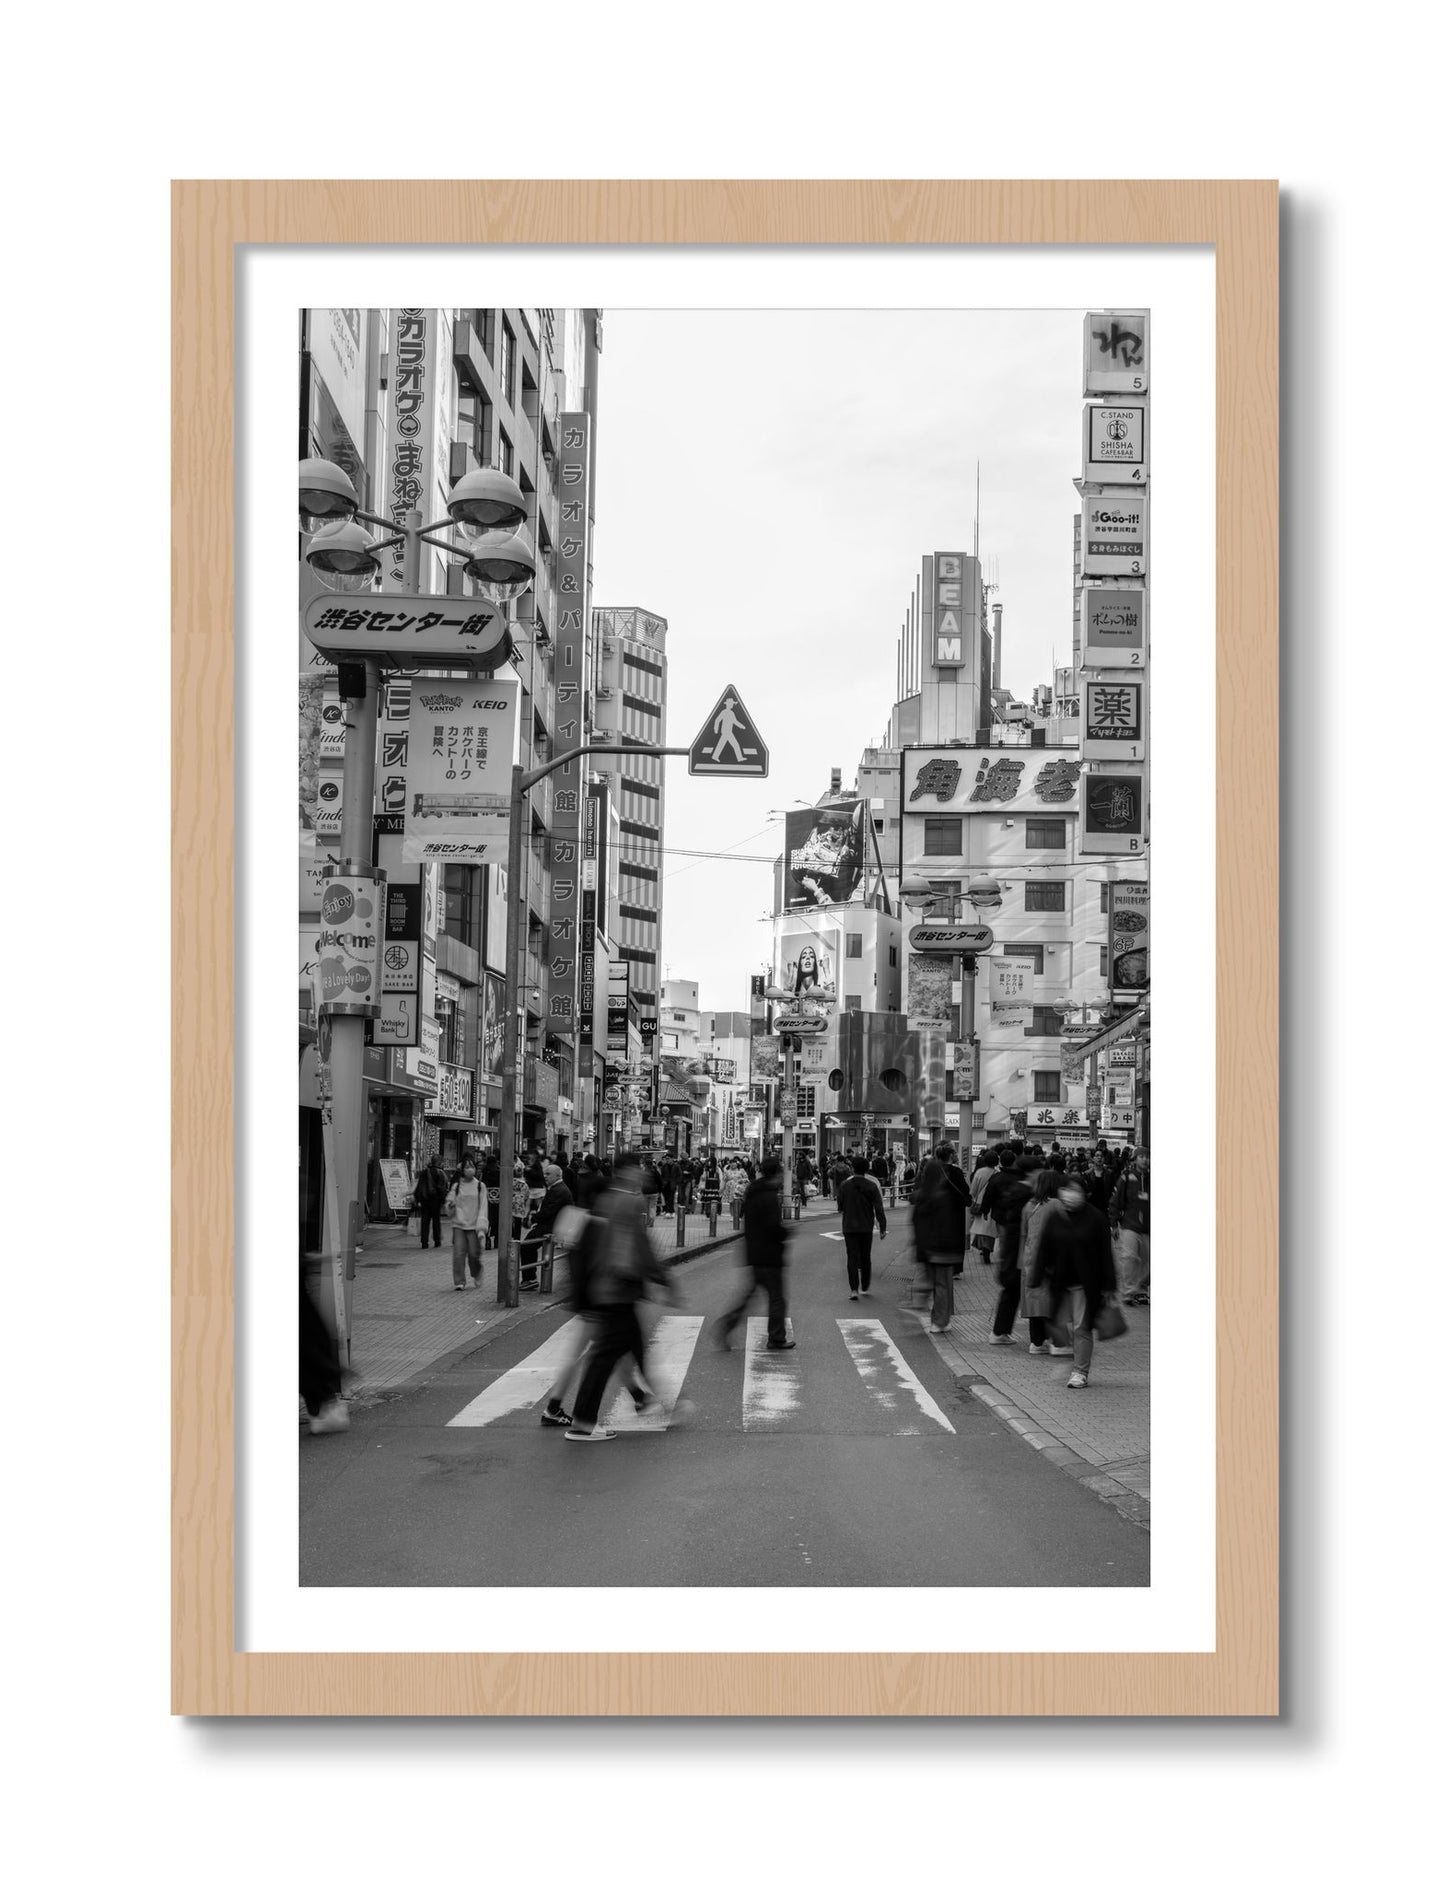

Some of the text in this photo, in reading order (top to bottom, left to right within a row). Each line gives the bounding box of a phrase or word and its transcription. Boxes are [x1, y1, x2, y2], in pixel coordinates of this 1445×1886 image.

[395, 316, 426, 416] カラオケ
[1133, 377, 1142, 389] 5
[1100, 411, 1134, 419] C.STAND
[1100, 441, 1134, 449] SHISHA
[1100, 511, 1140, 524] Goo-it!
[1131, 561, 1140, 573] 3
[938, 556, 962, 661] BEAM
[313, 608, 494, 636] 渋谷センター街
[1131, 653, 1140, 664] 2
[472, 700, 508, 710] KEIO
[1094, 688, 1131, 725] 薬
[432, 726, 445, 757] 冒険へ
[445, 726, 459, 780] カントーの
[476, 726, 489, 770] 京王線で
[1131, 746, 1137, 757] 1
[909, 757, 1083, 802] 角海老
[423, 843, 488, 853] 渋谷センター街
[1130, 839, 1138, 850] B
[323, 894, 353, 920] Enjoy
[320, 930, 376, 949] Welcome
[914, 931, 989, 941] 渋谷センター街
[381, 1019, 405, 1028] Whisky
[642, 1022, 657, 1031] GU
